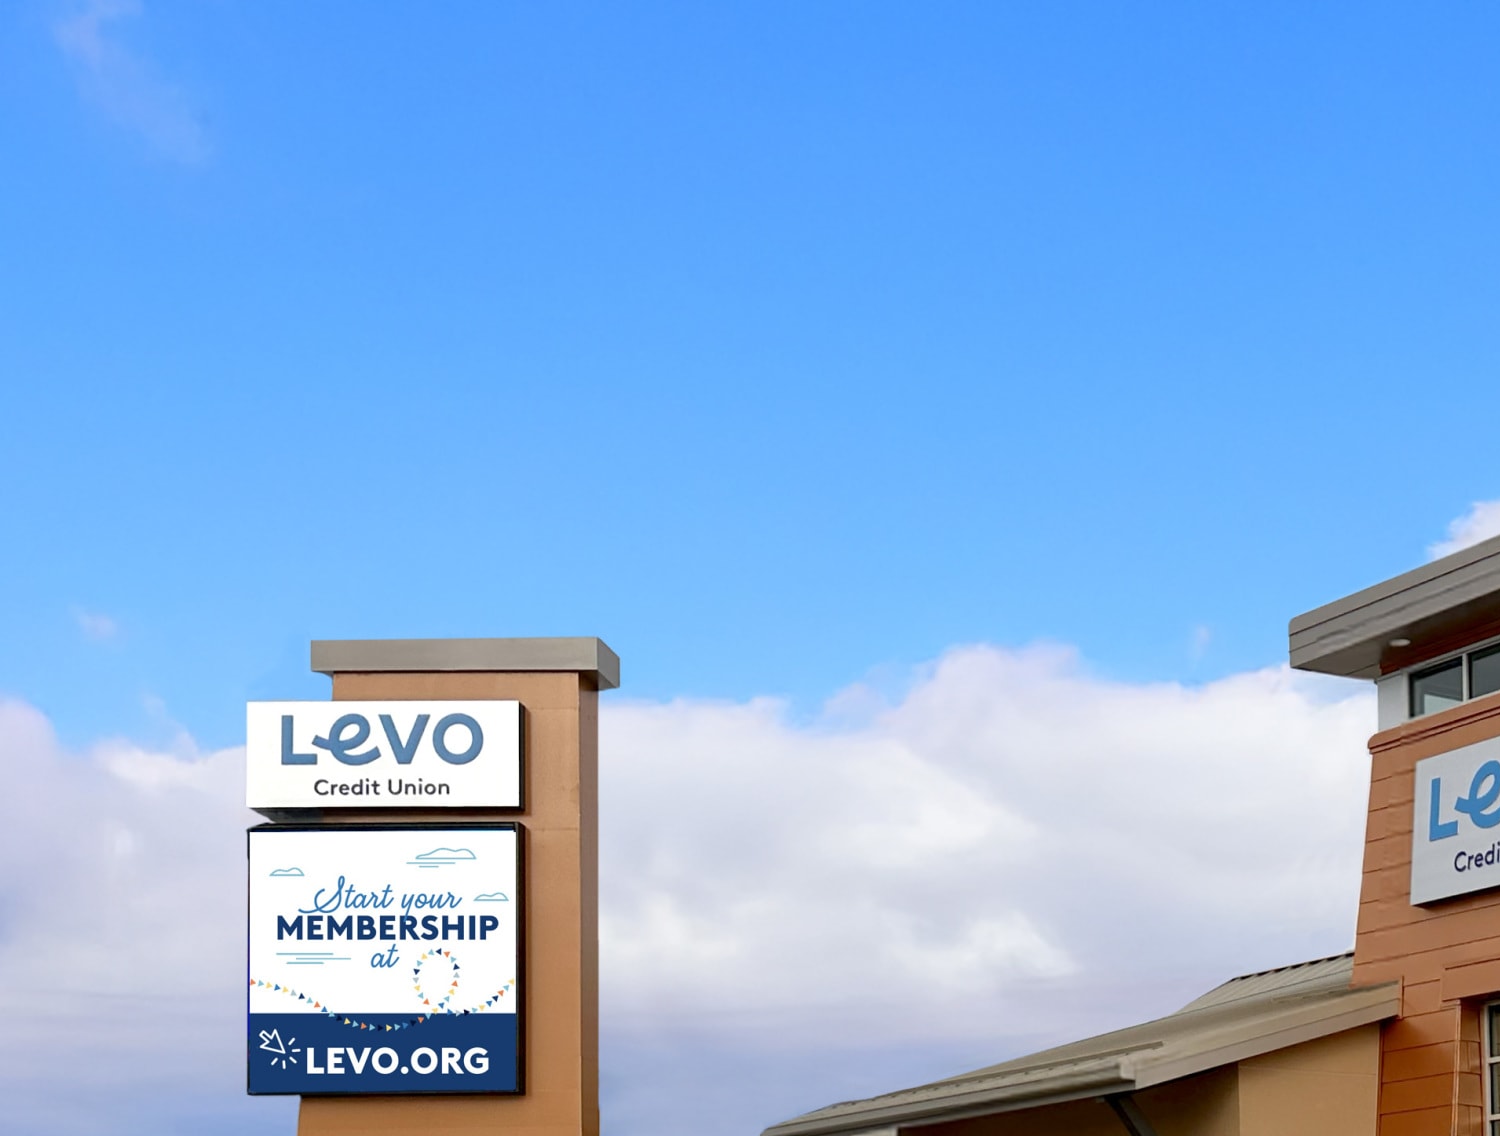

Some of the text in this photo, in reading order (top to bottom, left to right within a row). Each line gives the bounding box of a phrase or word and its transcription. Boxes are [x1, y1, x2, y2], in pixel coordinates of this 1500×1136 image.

[313, 778, 450, 796] Credit Union
[298, 875, 462, 923] Start your
[277, 915, 499, 940] MEMBERSHIP
[370, 943, 400, 968] at
[306, 1047, 489, 1075] LEVO.ORG
